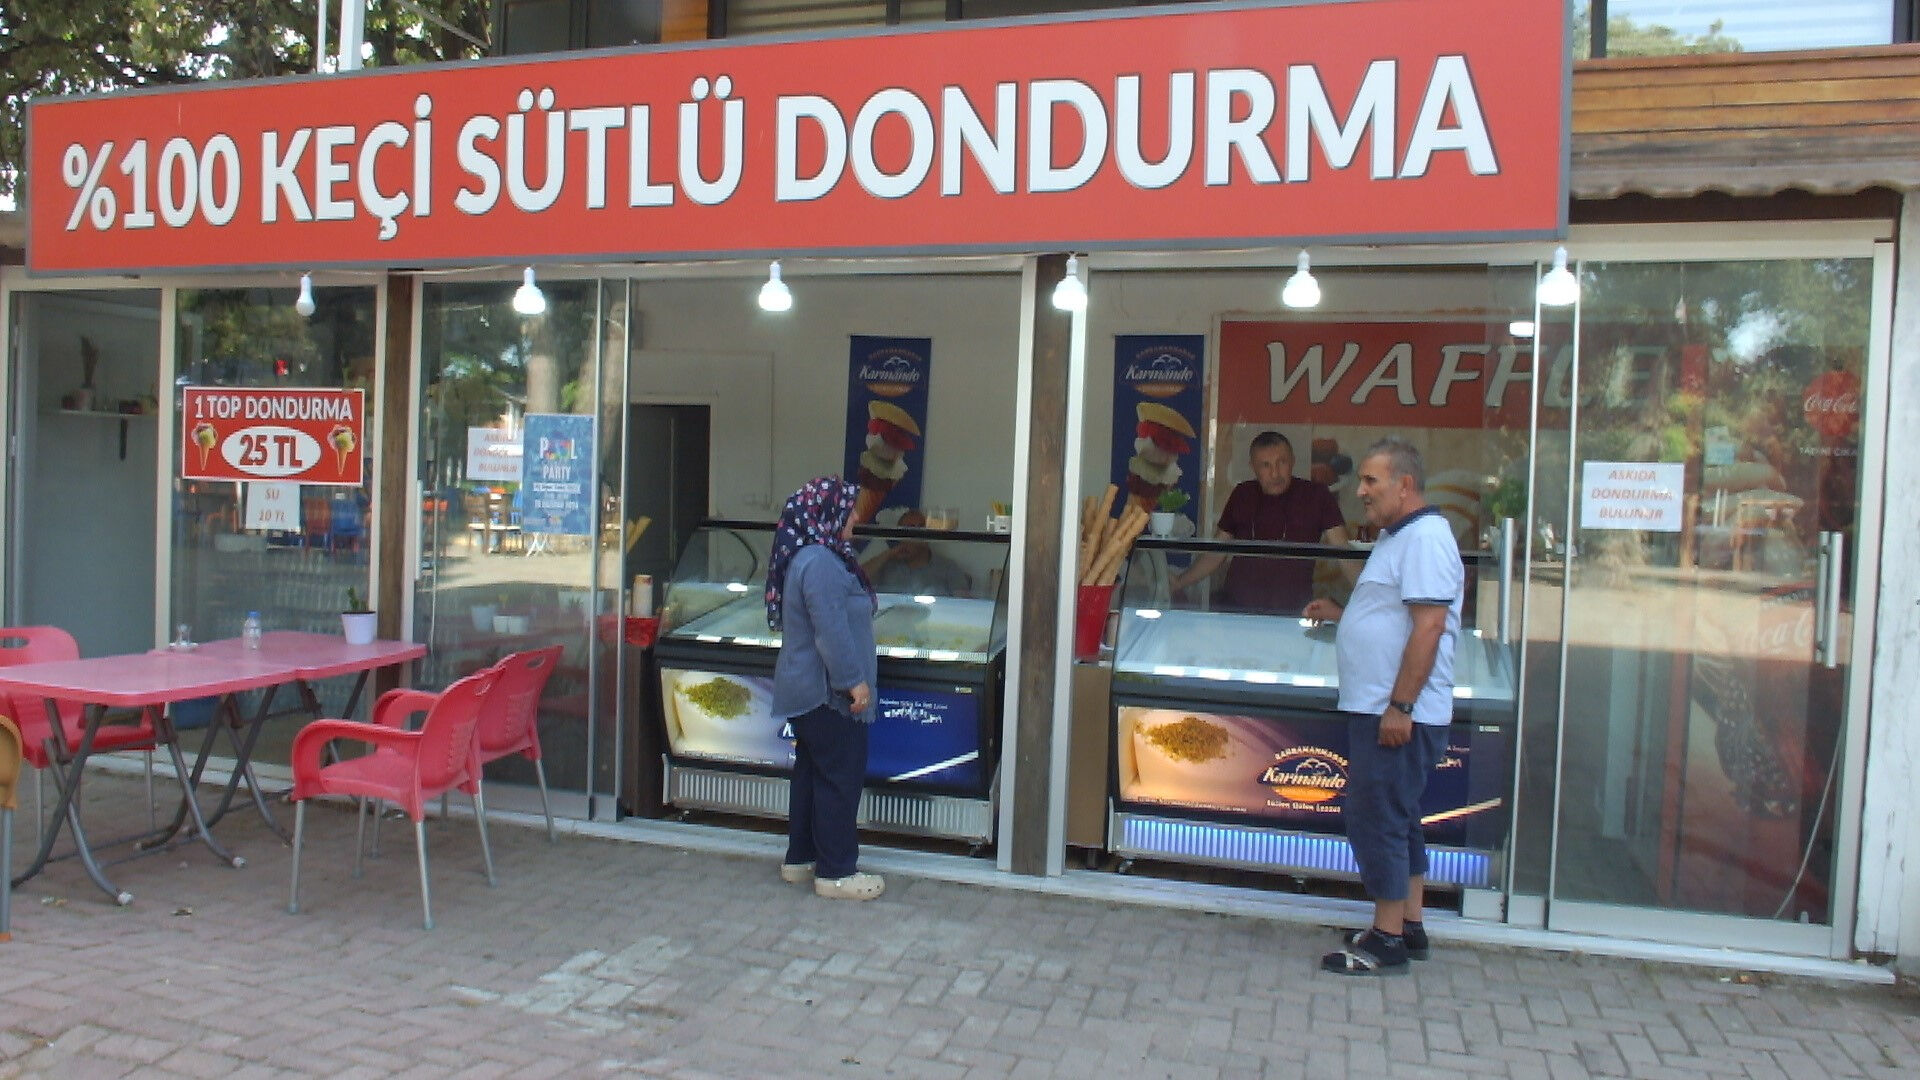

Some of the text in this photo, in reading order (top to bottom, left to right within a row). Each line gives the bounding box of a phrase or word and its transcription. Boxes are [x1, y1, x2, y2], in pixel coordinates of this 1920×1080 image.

[62, 53, 1499, 240] %100 KEÇİ SÜTLÜ DONDURMA
[195, 395, 353, 421] 1 TOP DONDURMA
[239, 434, 303, 468] 25 TL
[542, 464, 571, 480] PARTY
[1262, 766, 1347, 789] Karmando
